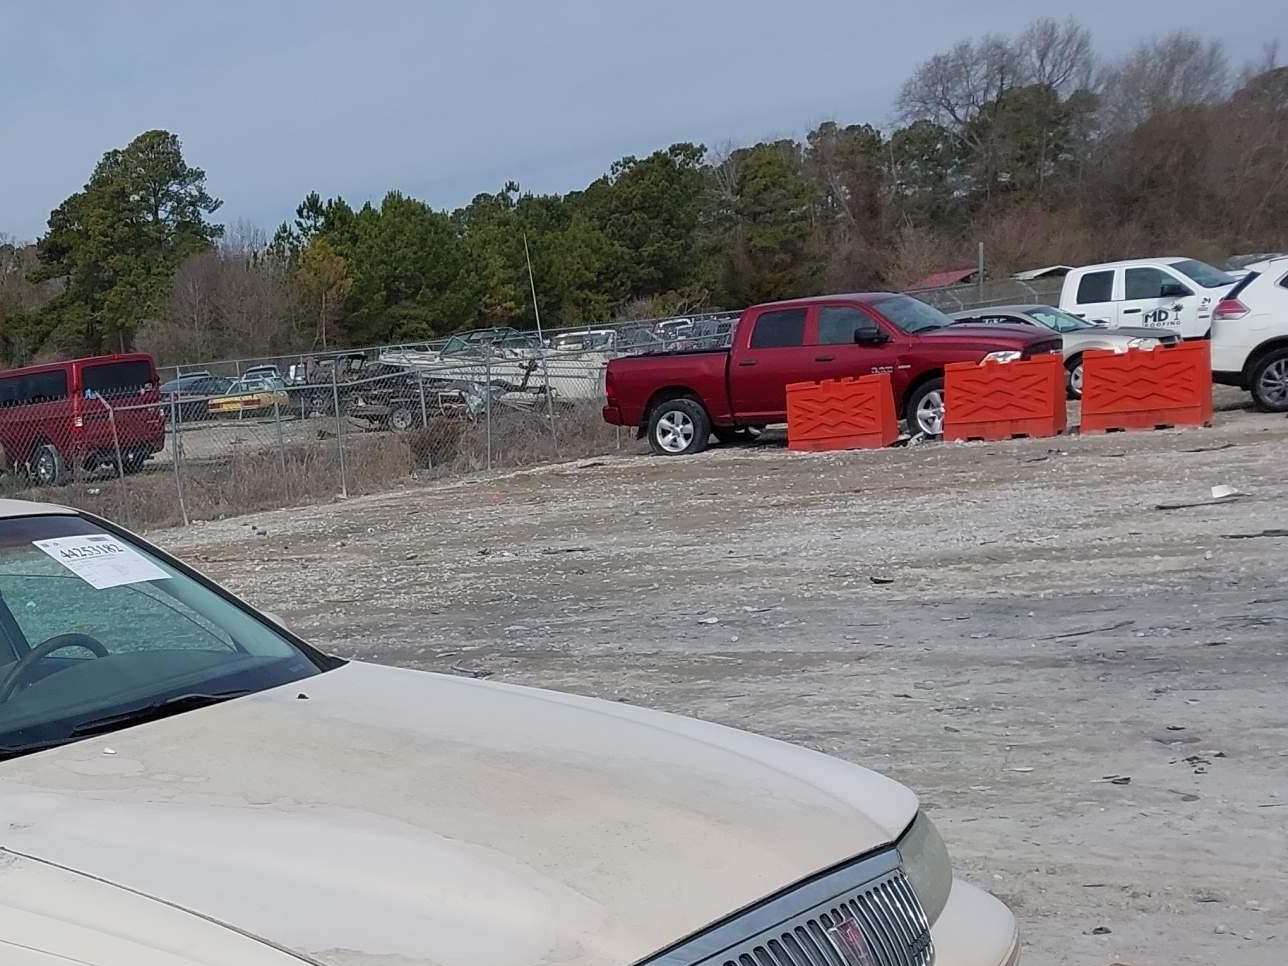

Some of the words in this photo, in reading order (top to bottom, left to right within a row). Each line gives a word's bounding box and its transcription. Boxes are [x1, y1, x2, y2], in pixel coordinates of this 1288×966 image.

[1145, 310, 1168, 323] MD
[1144, 320, 1181, 328] ROOFING
[60, 543, 124, 559] 44253182
